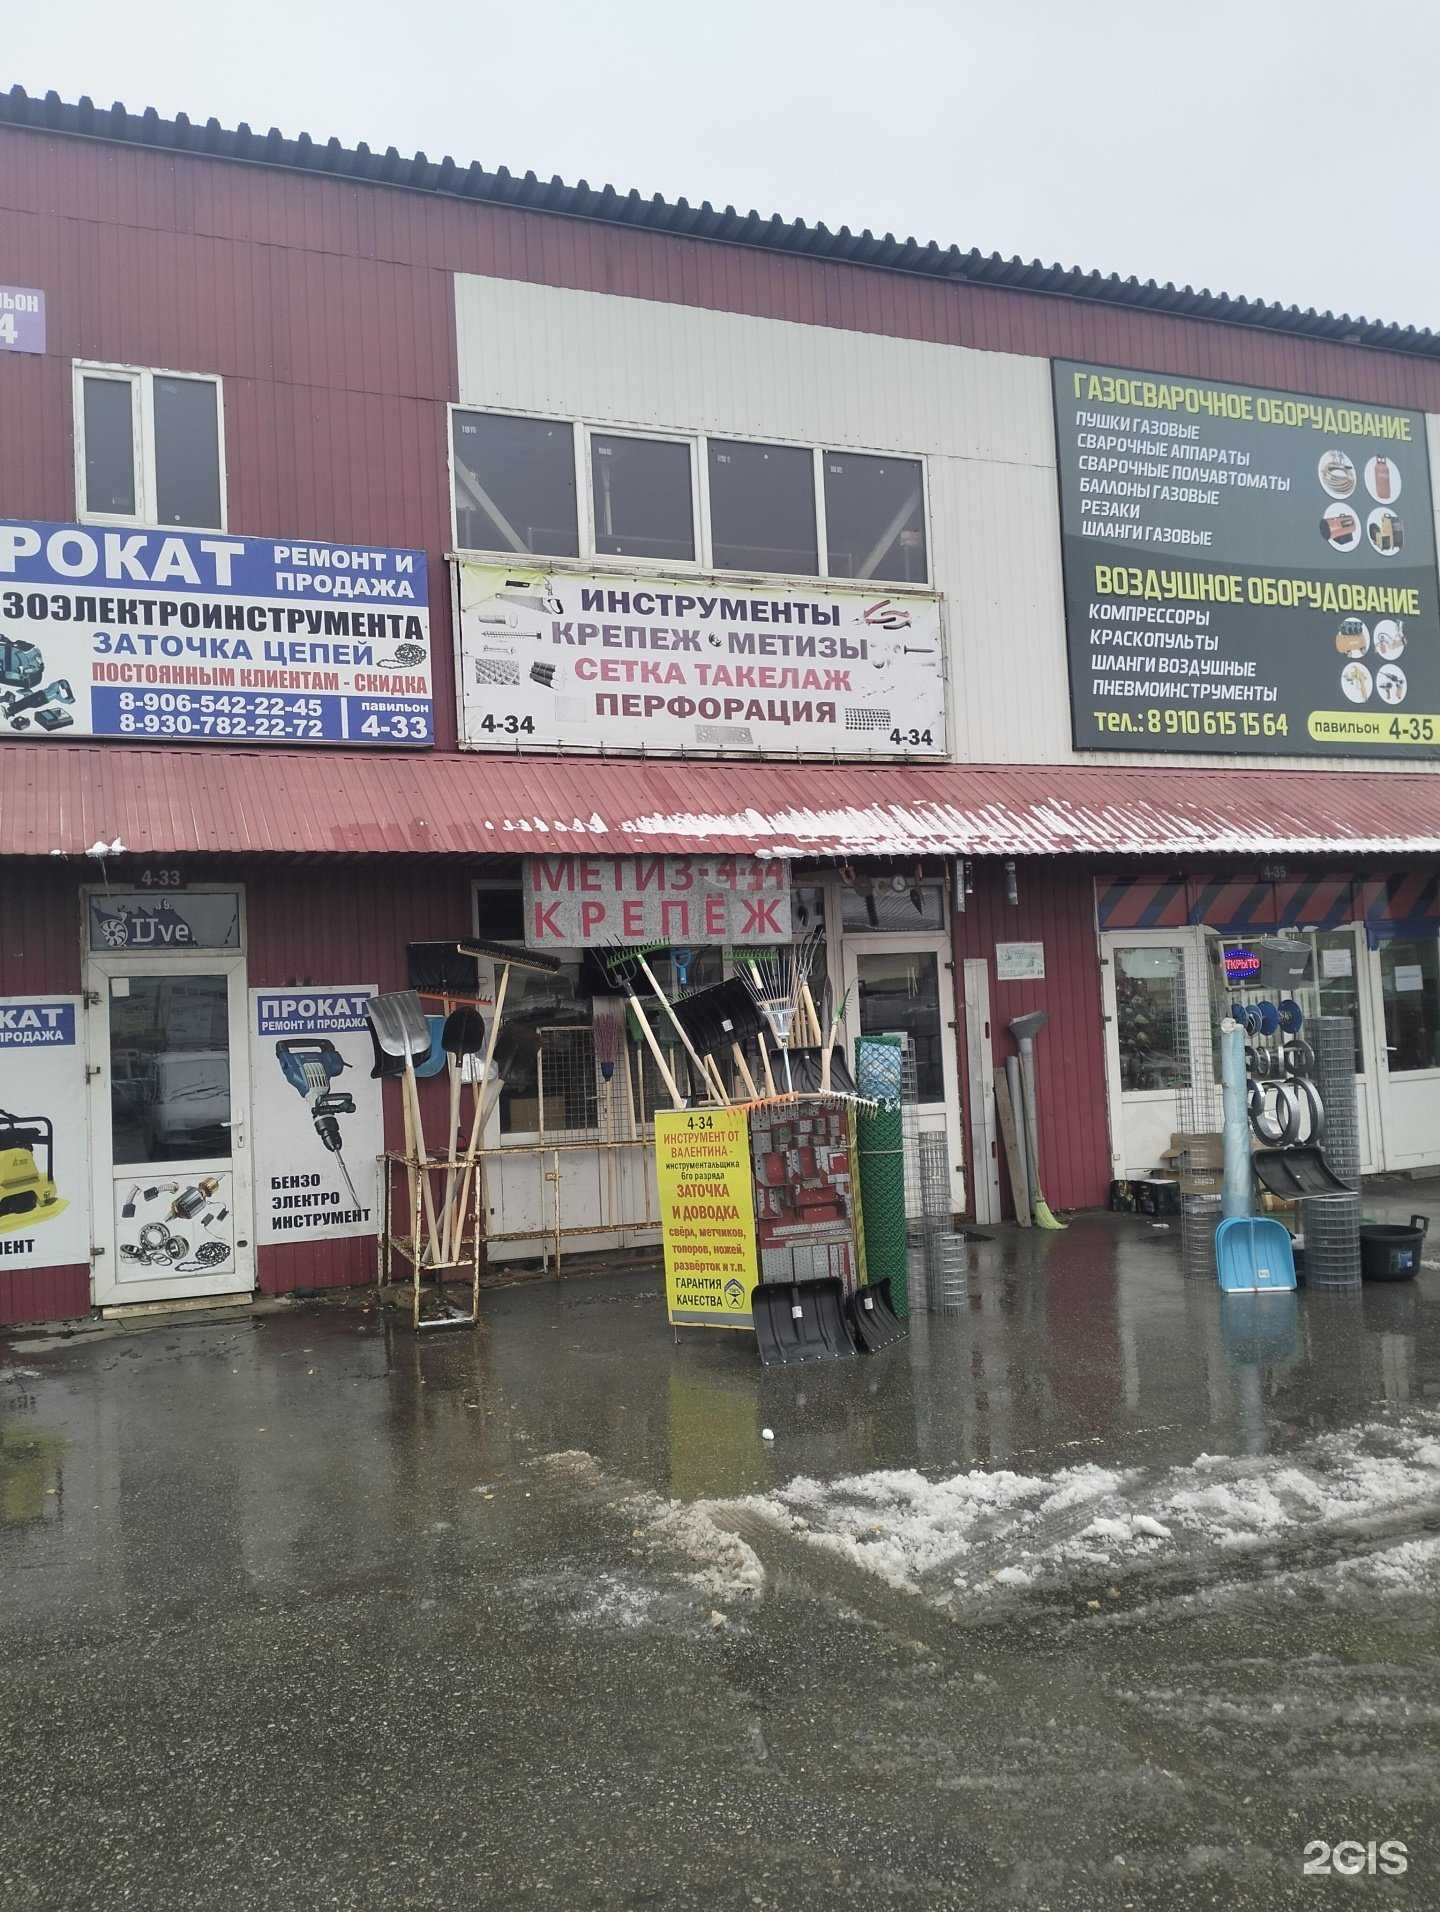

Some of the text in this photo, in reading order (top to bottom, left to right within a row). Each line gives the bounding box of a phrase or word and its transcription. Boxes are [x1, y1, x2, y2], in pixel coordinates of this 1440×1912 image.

[0, 292, 38, 312] ЬОН
[1073, 372, 1412, 442] ГАЗОСВАРОЧНОЕ ОБОРУДОВАНИЕ
[1076, 411, 1200, 440] ПУШКИ ГАЗОВЫЕ
[1077, 433, 1250, 466] СВАРОЧНЫЕ АППАРАТЫ
[1078, 455, 1291, 492] СВАРОЧНЫЕ ПОЛУАВТОМАТЫ
[1079, 477, 1220, 506] БАЛЛОНЫ ГАЗОВЫЕ
[1081, 500, 1140, 519] РЕЗАКИ
[1082, 520, 1213, 547] ШЛАНГИ ГАЗОВЫЕ
[0, 526, 244, 586] РОКАТ
[273, 545, 413, 573] РЕМОНТ И
[276, 572, 415, 599] ПРОДАЖА
[1095, 565, 1421, 616] ВОЗДУШНОЕ ОБОРУДОВАНИЕ
[3, 591, 424, 641] ЗОЭЛЕКТРОИНСТРУМЕНТА
[581, 588, 840, 627] ИНСТРУМЕНТЫ
[1088, 603, 1210, 626] КОМПРЕССОРЫ
[92, 632, 373, 666] ЗАТОЧКА ЦЕПЕЙ
[551, 621, 868, 661] КРЕПЕЖ МЕТИЗЫ
[1090, 629, 1219, 651] КРАСКОПУЛЬТЫ
[574, 658, 853, 692] СЕТКА ТАКЕЛАЖ
[1091, 655, 1257, 678] ШЛАНГИ ВОЗДУШНЫЕ
[92, 662, 235, 687] ПОСТОЯННЫМ
[240, 668, 339, 691] КЛИЕНТАМ
[354, 675, 428, 696] СКИДКА
[1092, 679, 1278, 702] ПНЕВМОИНСТРУМЕНТЫ
[119, 692, 322, 717] 8-906-542-22-45
[361, 700, 429, 713] павильон
[594, 693, 837, 725] ПЕРФОРАЦИЯ
[119, 714, 323, 737] 8-930-782-22-72
[361, 716, 428, 739] 4-33
[480, 714, 535, 735] 4-34
[1315, 721, 1380, 735] павильон
[1389, 717, 1434, 740] 4-35
[889, 728, 934, 747] 4-34
[142, 870, 180, 886] 4-33
[1225, 959, 1260, 970] ТКРЫТО
[0, 1008, 63, 1029] КАТ
[261, 997, 368, 1019] ПРОКАТ
[262, 1017, 368, 1032] РЕМОНТ И ПРОДАЖА
[688, 1116, 713, 1130] 4-34
[664, 1131, 739, 1144] ИНСТРУМЕНТ ОТ
[671, 1146, 728, 1158] ВАЛЕНТИНА
[666, 1161, 740, 1171] инструментальщика
[694, 1172, 725, 1181] разряда
[271, 1174, 320, 1190] БЕНЗО
[677, 1184, 730, 1198] ЗАТОЧКА
[272, 1192, 340, 1210] ЭЛЕКТРО
[272, 1208, 371, 1230] ИНСТРУМЕНТ
[672, 1206, 740, 1221] И ДОВОДКА
[672, 1244, 745, 1257] топоров, ножей,
[675, 1277, 722, 1290] ГАРАНТИЯ
[676, 1294, 723, 1307] КАЧЕСТВА
